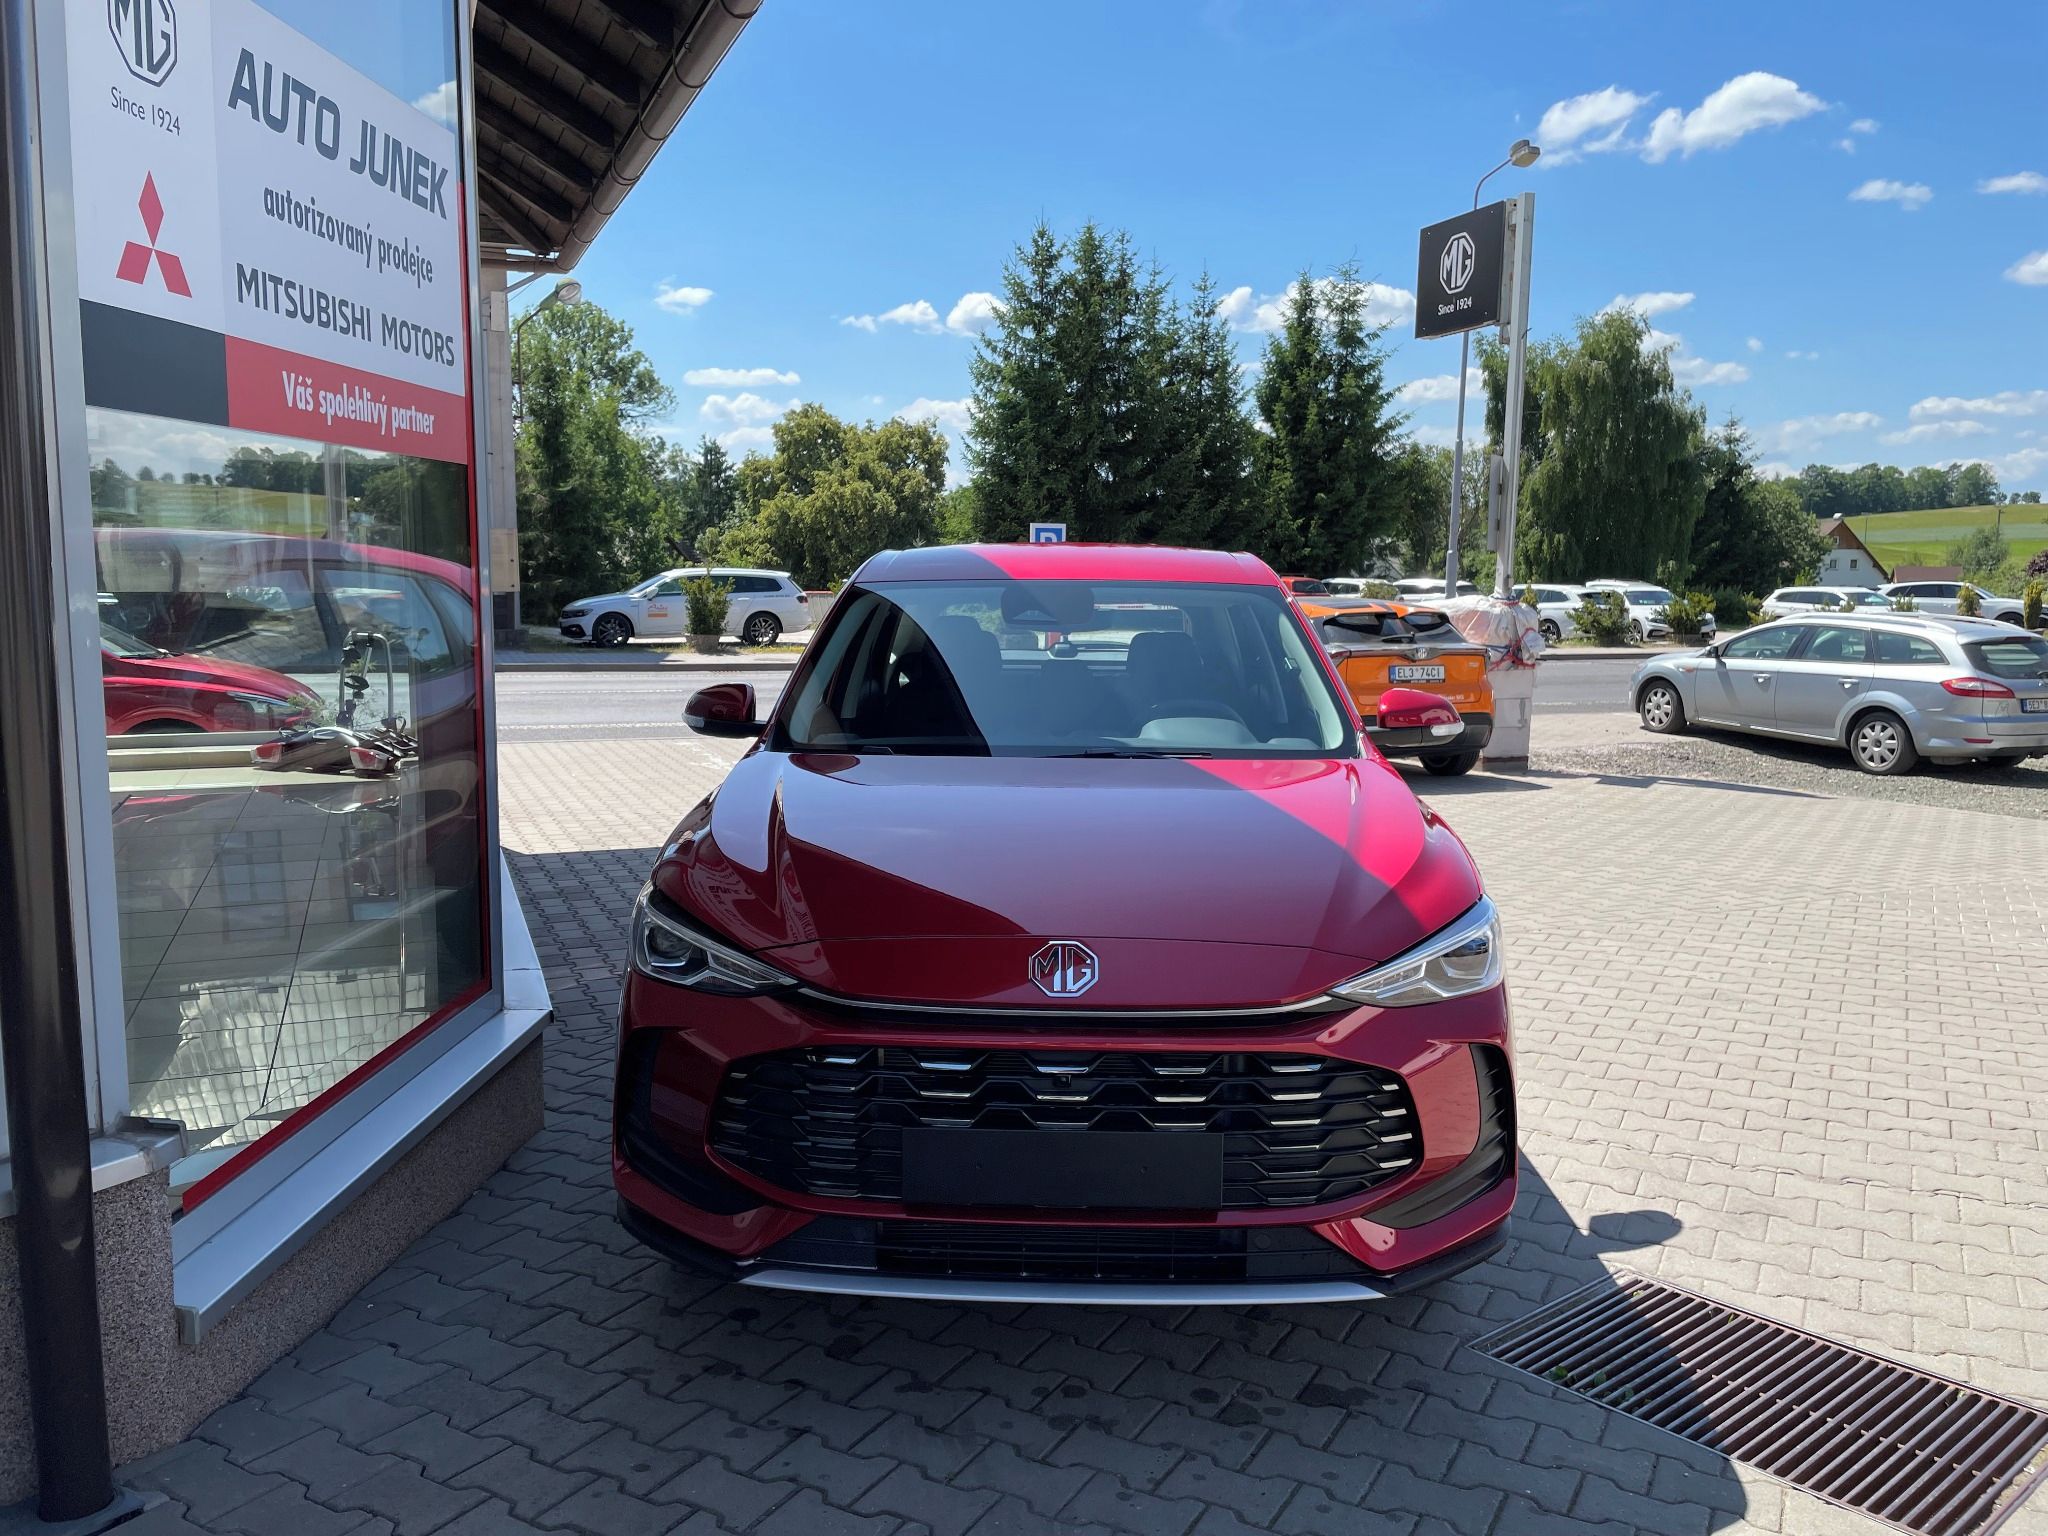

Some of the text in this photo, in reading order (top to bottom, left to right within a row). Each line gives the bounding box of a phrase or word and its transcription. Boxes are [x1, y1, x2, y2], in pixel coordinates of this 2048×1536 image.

[114, 0, 171, 75] MG
[110, 86, 181, 137] Since 1924
[227, 47, 449, 220] AUTO JUNEK
[263, 186, 433, 289] autorizovaný prodejce
[1443, 237, 1472, 289] MG
[236, 262, 455, 367] MITSUBISHI MOTORS
[1437, 296, 1473, 316] Since 1924
[282, 370, 435, 438] Váš spolehlivý partner
[1035, 946, 1092, 992] MG
